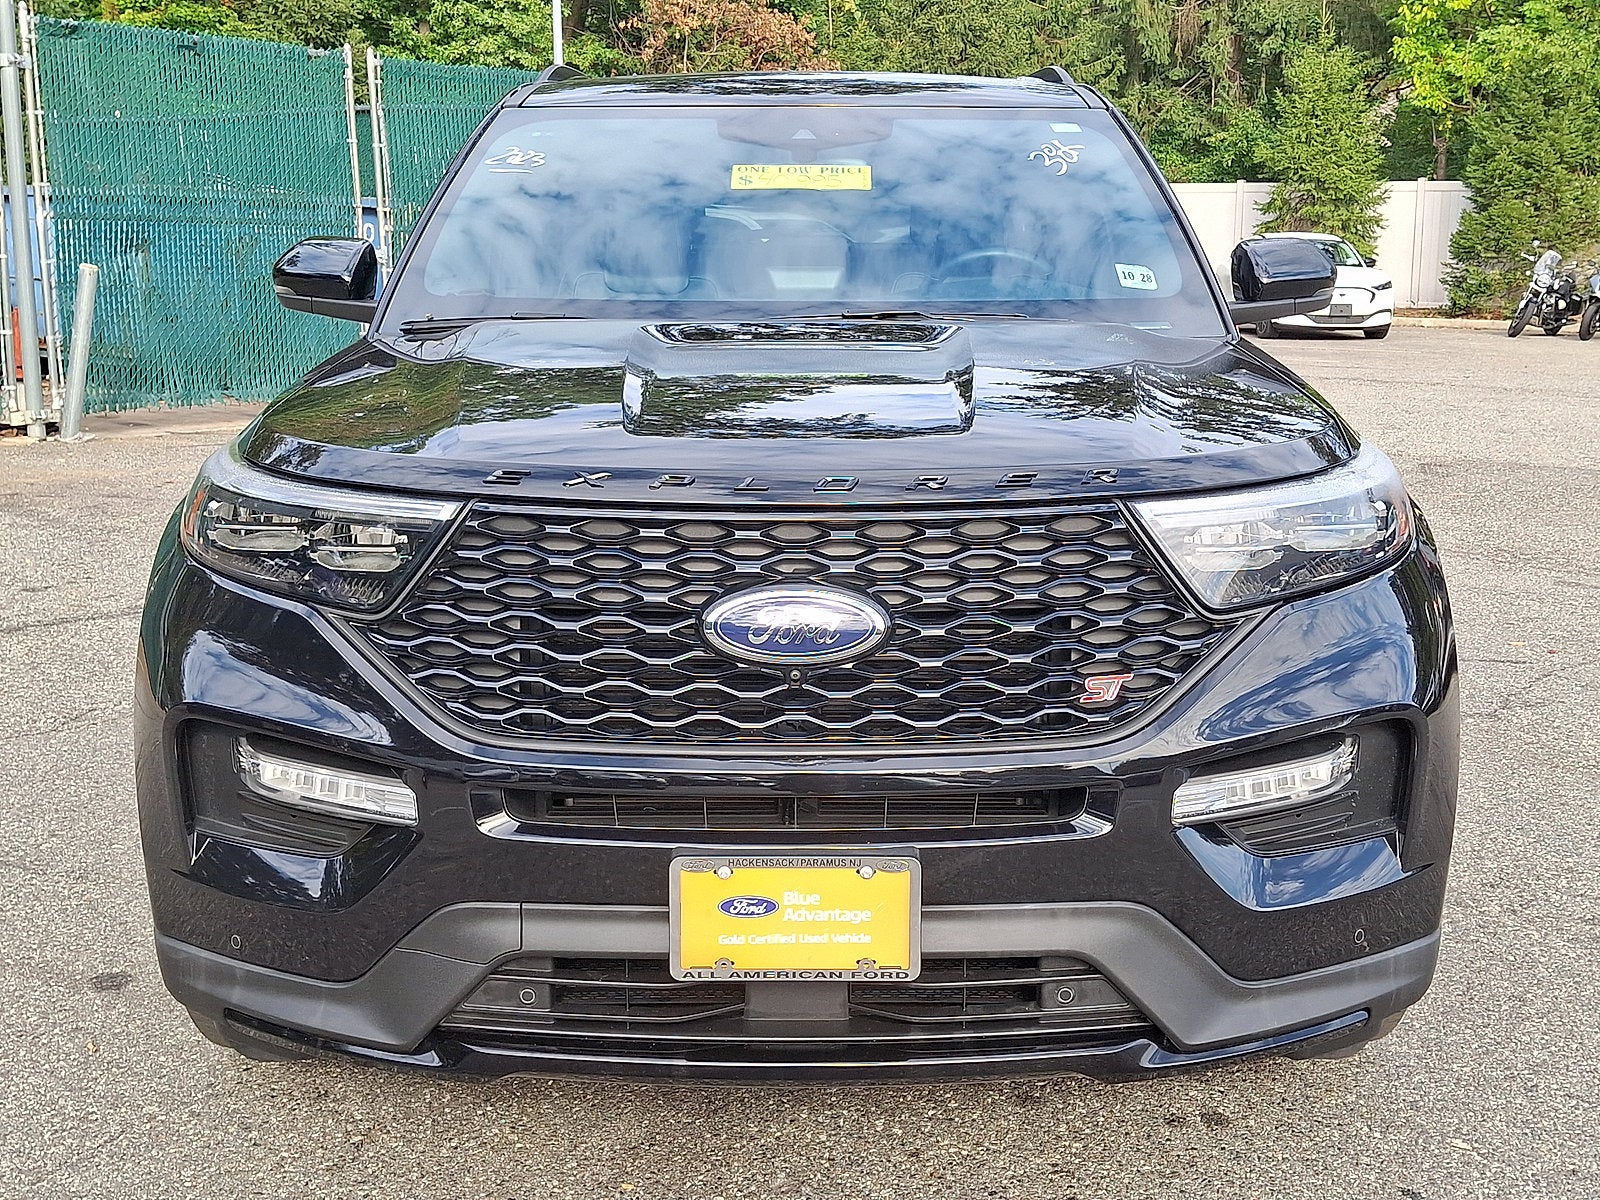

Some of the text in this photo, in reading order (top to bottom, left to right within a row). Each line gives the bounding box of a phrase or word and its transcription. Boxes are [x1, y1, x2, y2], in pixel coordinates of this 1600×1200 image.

[1121, 270, 1153, 284] 10 28
[481, 467, 1124, 494] EXPLORER
[1079, 673, 1135, 704] ST
[849, 858, 863, 869] NJ
[783, 890, 821, 906] Blue
[729, 898, 768, 915] Ford
[784, 908, 872, 924] Advantage
[718, 933, 872, 945] Gold Certified Used Vehicle
[681, 970, 910, 979] ALL AMERICAN FORD
